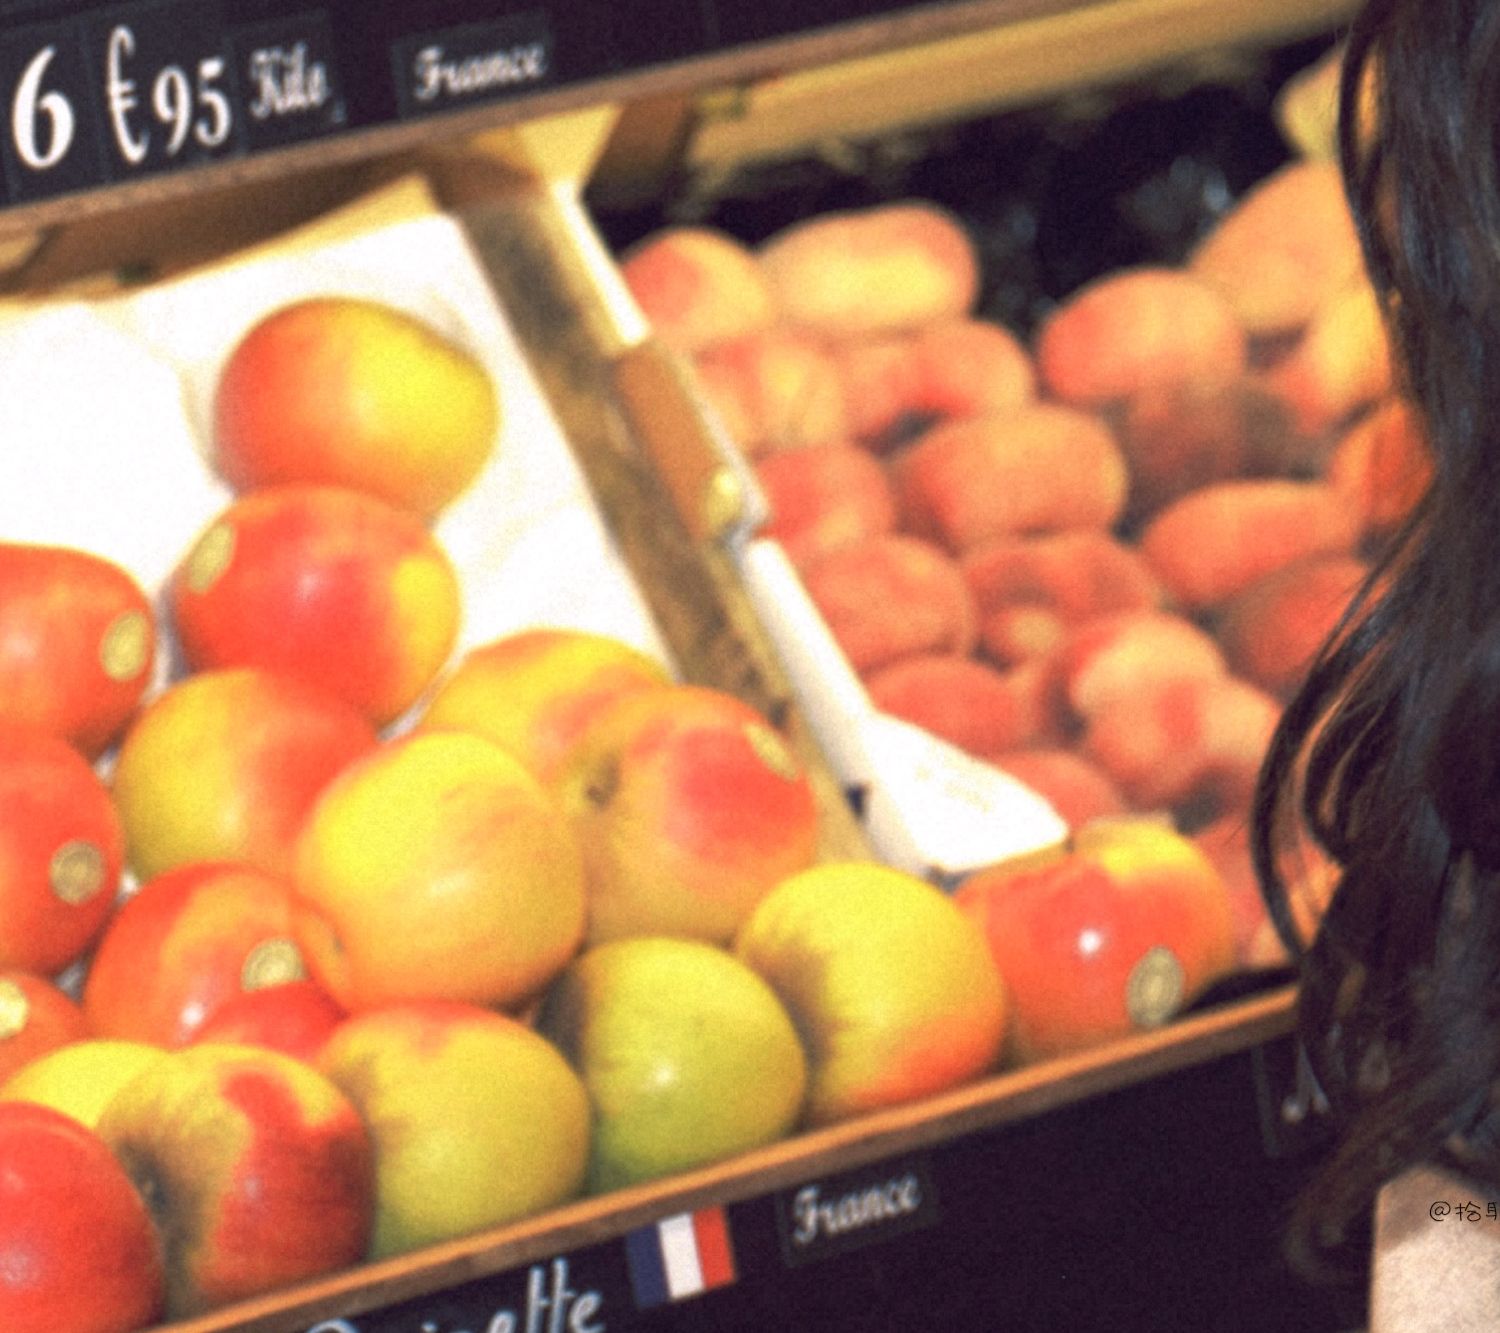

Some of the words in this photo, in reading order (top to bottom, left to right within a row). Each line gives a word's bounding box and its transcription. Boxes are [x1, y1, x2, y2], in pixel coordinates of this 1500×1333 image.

[12, 44, 76, 171] 6
[414, 42, 549, 103] France
[793, 1172, 923, 1245] France
